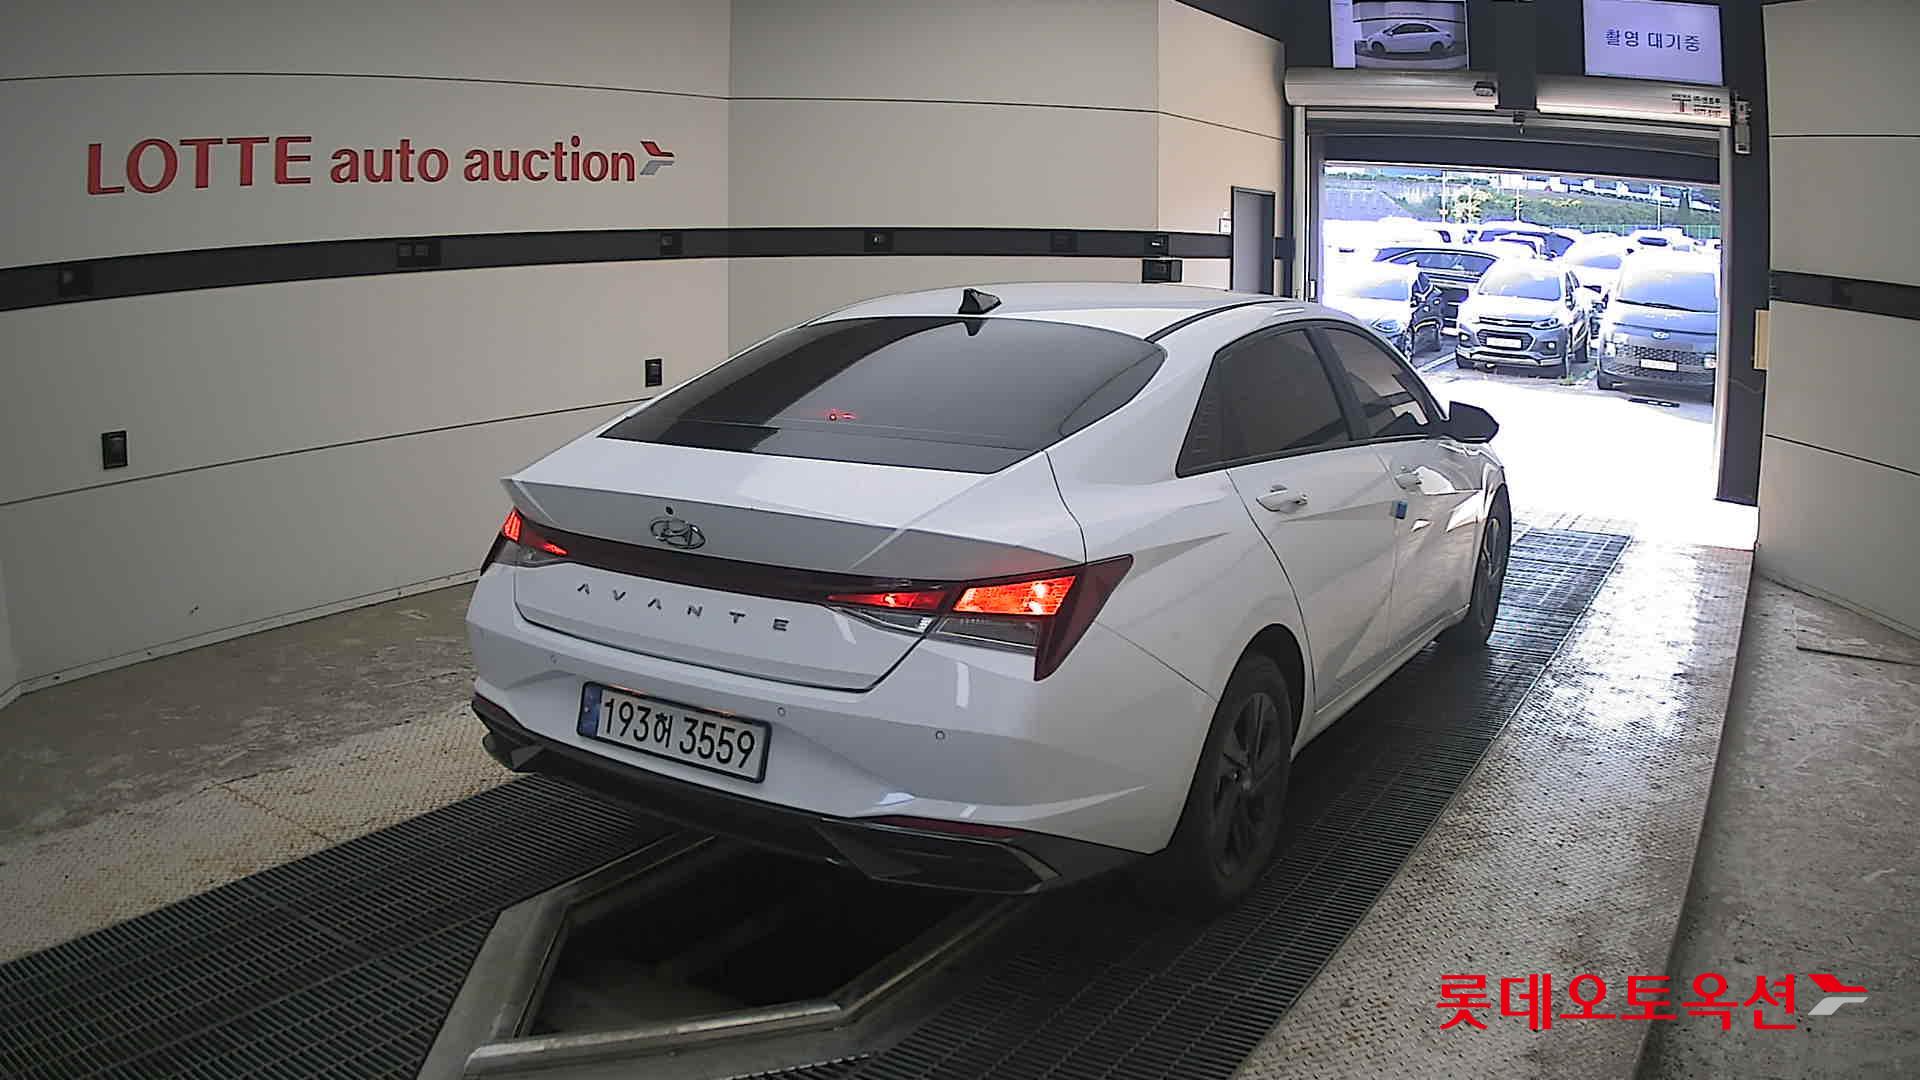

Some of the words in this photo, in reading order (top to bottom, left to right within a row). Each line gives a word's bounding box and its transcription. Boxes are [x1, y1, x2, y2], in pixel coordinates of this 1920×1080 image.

[1604, 28, 1640, 48] 촬영
[1647, 31, 1701, 53] 대기중
[87, 135, 313, 196] LOTTE
[330, 138, 449, 184] auto
[464, 134, 637, 183] auction
[576, 582, 790, 632] AVANTE
[604, 698, 673, 748] 193허
[679, 716, 756, 769] 3559
